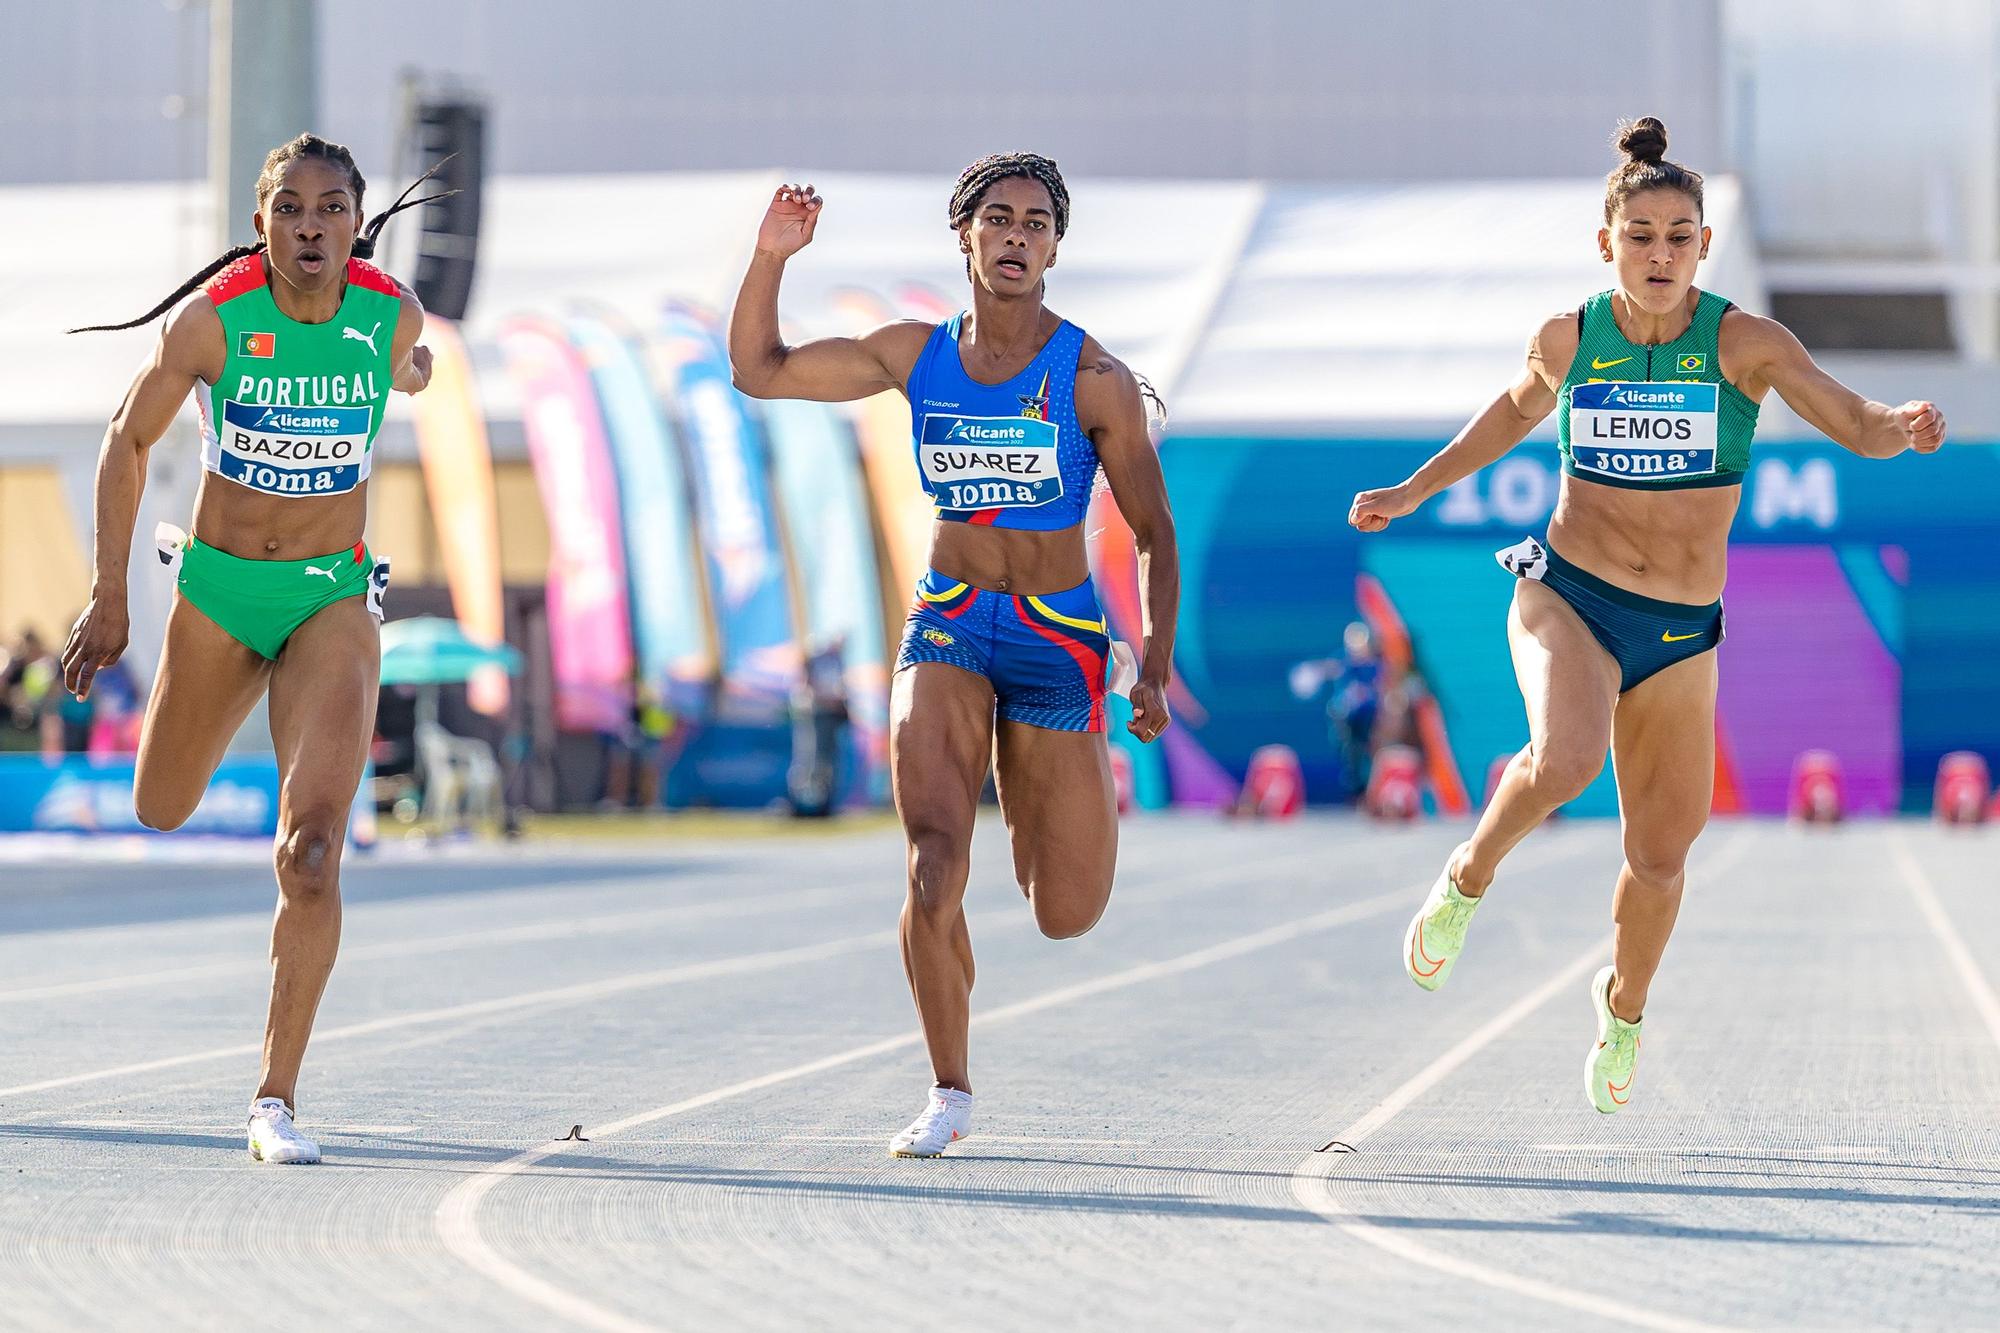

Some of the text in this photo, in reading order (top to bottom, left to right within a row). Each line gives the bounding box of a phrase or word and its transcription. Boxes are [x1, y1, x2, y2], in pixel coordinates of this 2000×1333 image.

[236, 371, 380, 406] PORTUGAL
[922, 399, 960, 409] ECUADOR
[1593, 416, 1692, 440] LEMOS
[234, 431, 352, 460] BAZOLO
[933, 451, 1042, 474] SUAREZ
